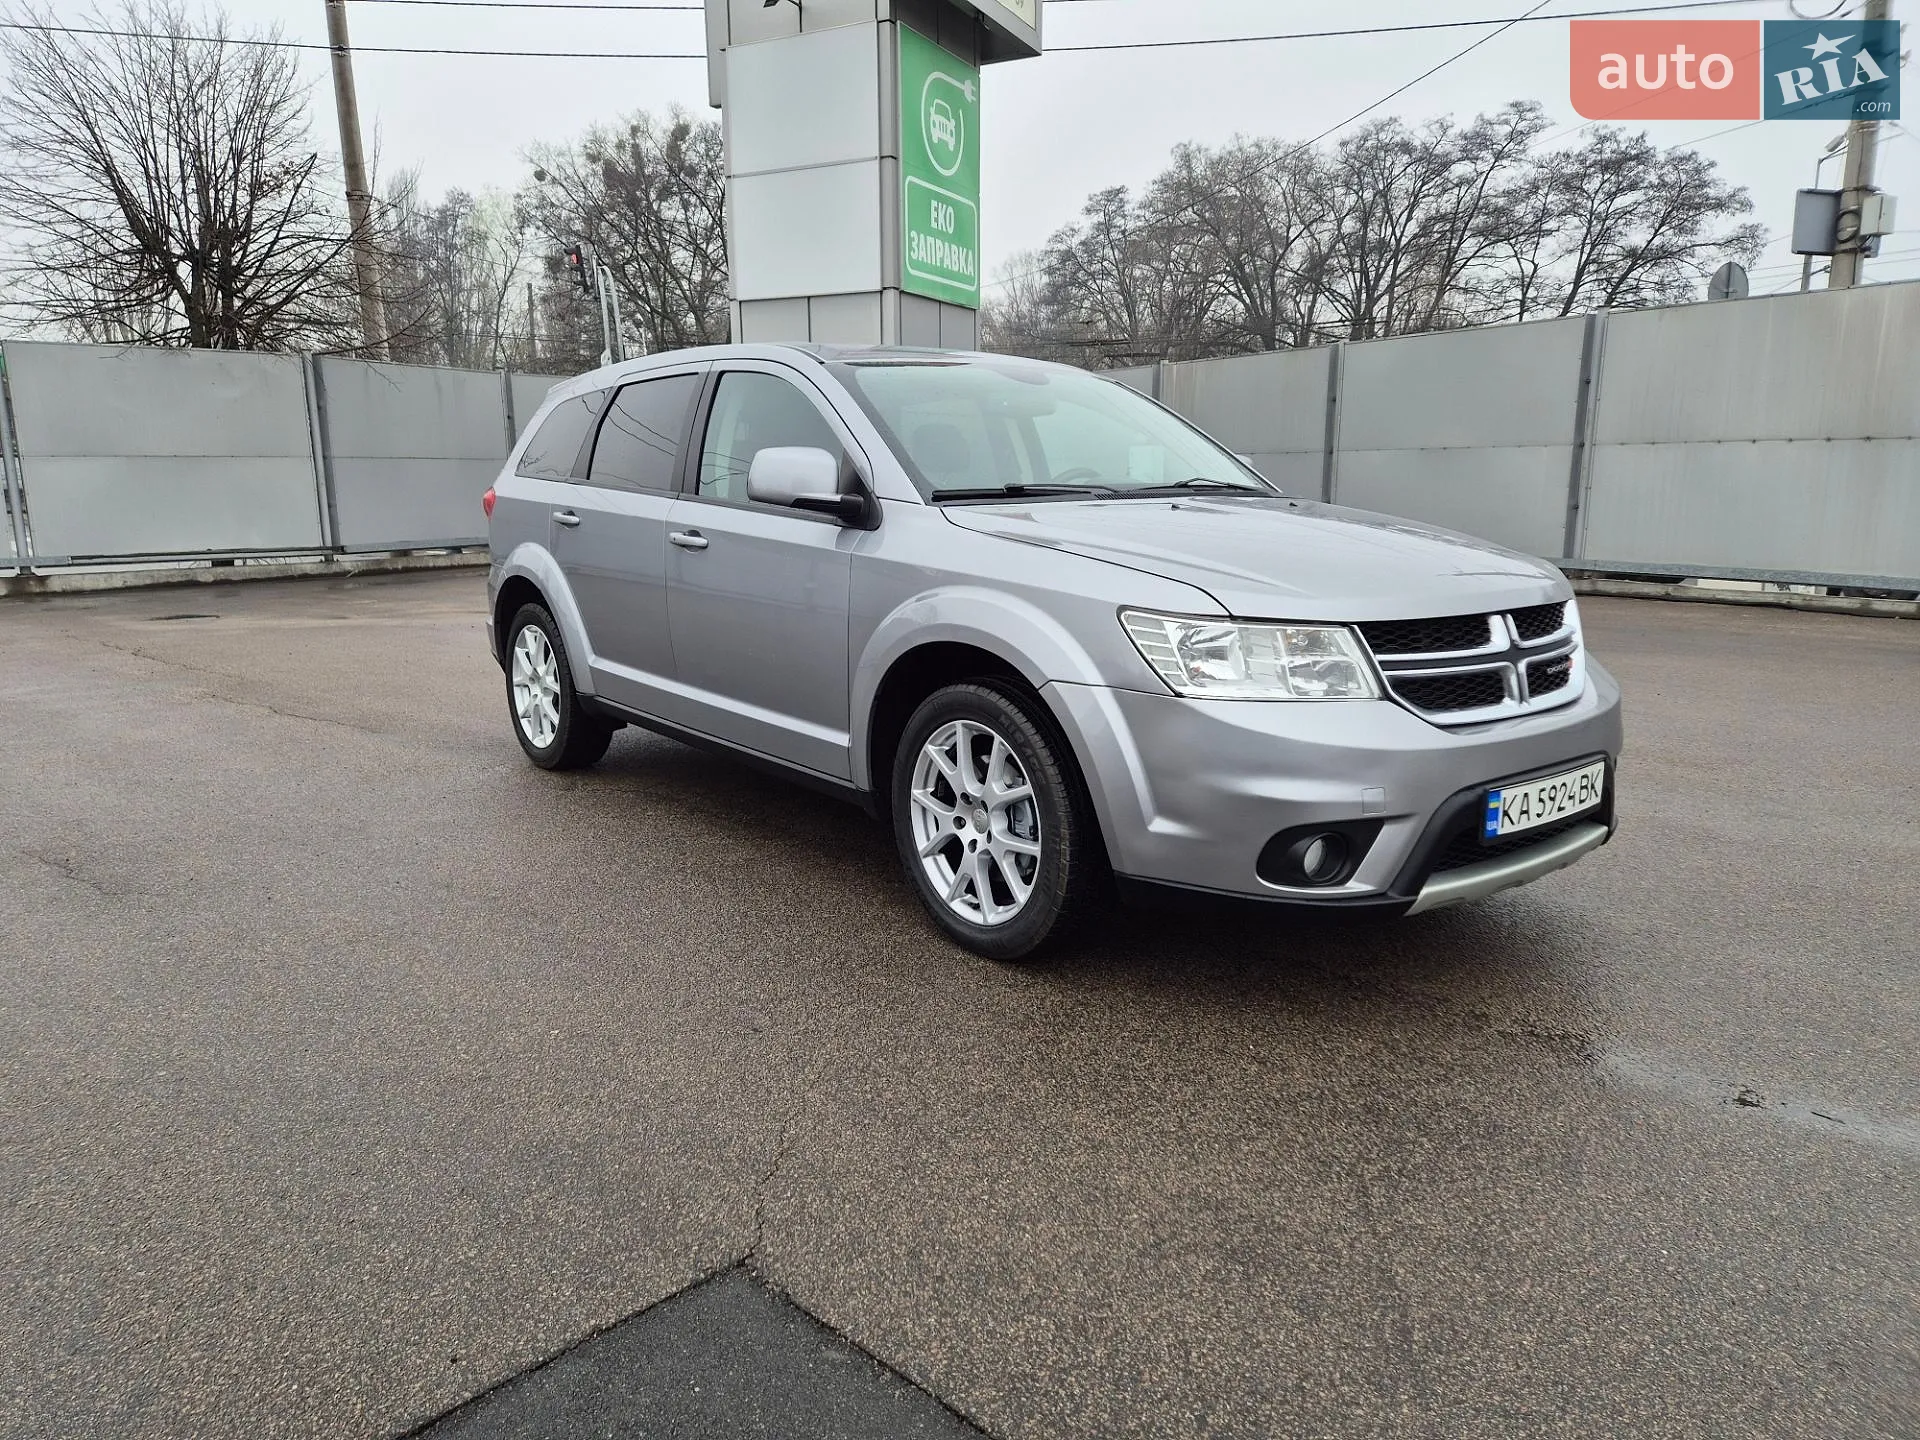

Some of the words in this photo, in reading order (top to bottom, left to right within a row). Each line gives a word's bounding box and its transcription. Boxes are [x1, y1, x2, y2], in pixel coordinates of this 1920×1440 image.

[930, 200, 955, 234] ЕКО
[910, 230, 974, 277] ЗАПРАВКА
[1536, 777, 1577, 818] 5924
